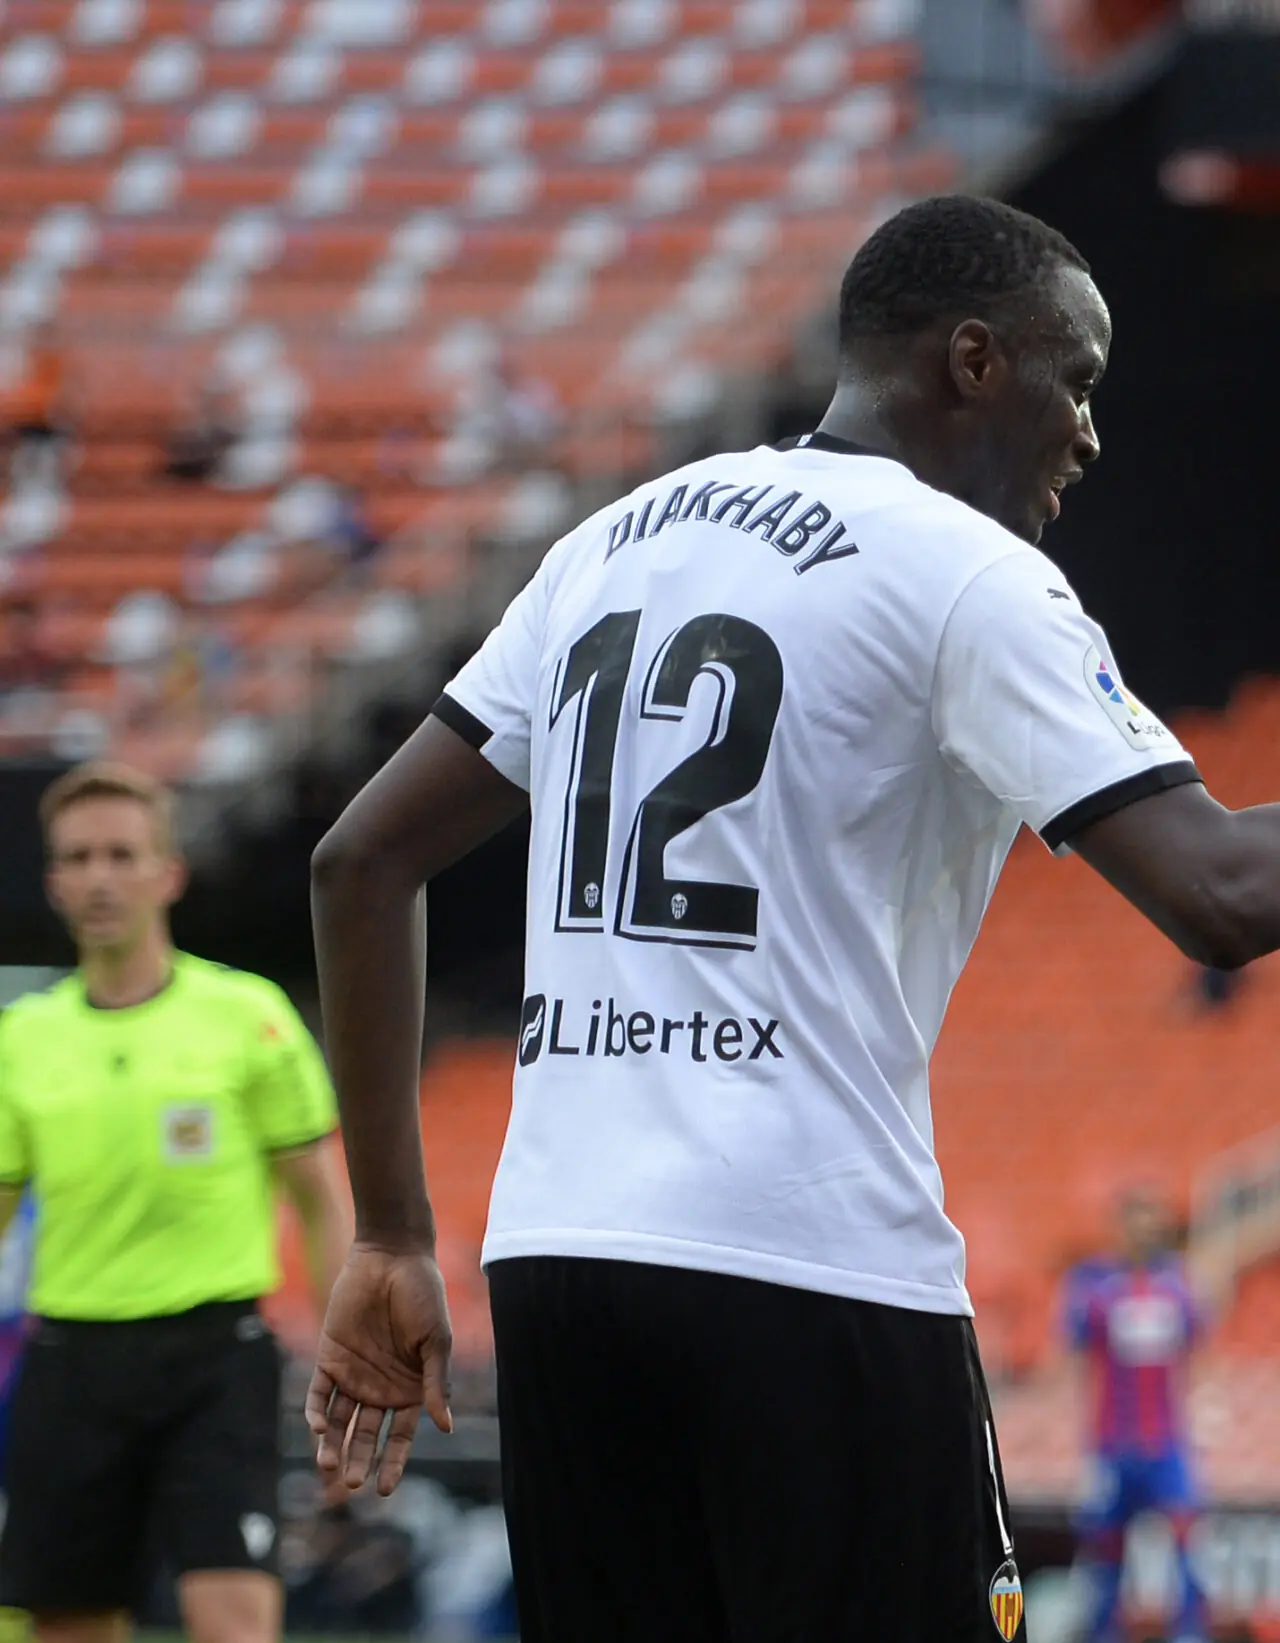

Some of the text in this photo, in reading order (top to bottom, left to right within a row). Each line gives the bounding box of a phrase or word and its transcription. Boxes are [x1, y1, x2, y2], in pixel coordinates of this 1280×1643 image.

[603, 480, 860, 576] DIAKHABY
[548, 608, 784, 952] 12
[549, 997, 785, 1062] Libertex
